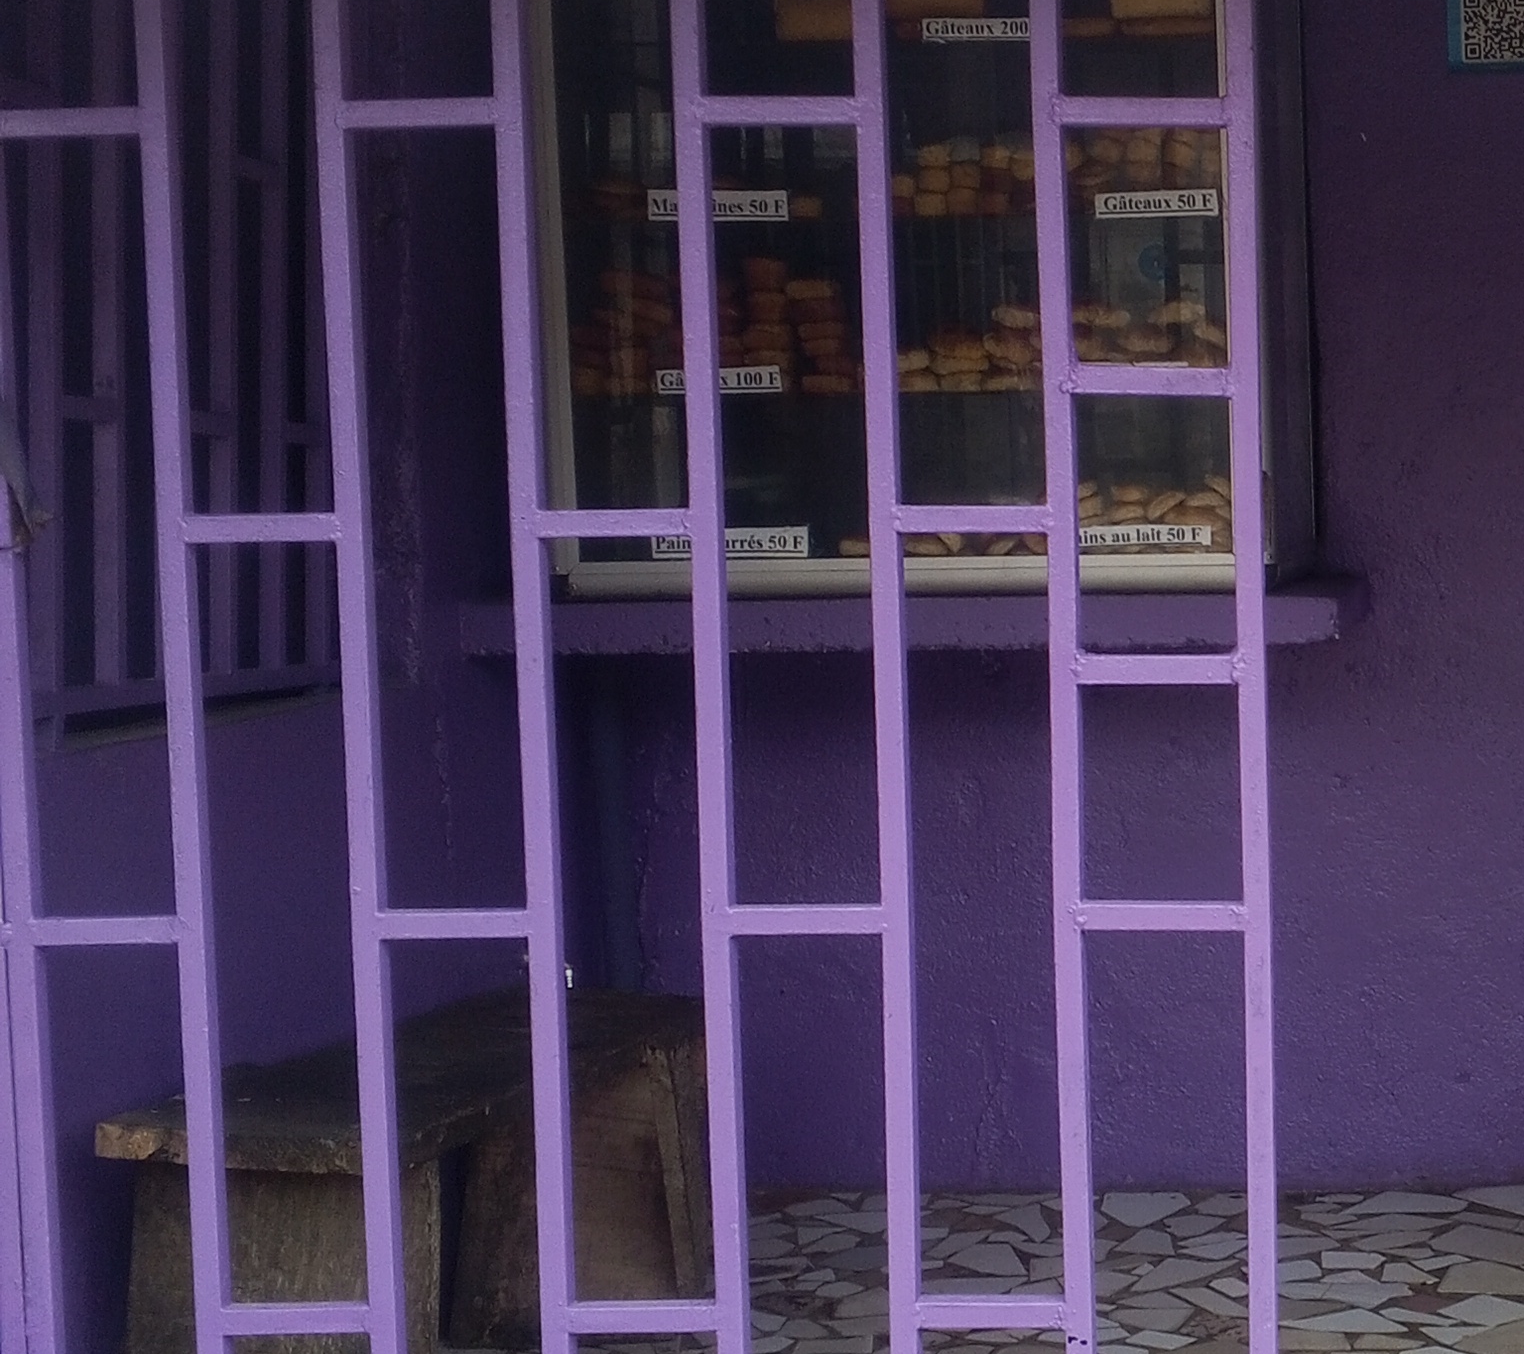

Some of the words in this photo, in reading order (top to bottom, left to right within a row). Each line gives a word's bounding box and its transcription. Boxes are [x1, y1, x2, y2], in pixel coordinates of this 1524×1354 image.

[925, 20, 995, 35] Gâteaux
[1000, 20, 1029, 35] 200
[748, 199, 768, 214] 50
[774, 199, 785, 213] F
[1103, 193, 1172, 210] Gâteaux
[1177, 194, 1196, 209] 50
[1201, 193, 1213, 208] F
[735, 371, 763, 386] 100
[768, 371, 779, 385] F
[768, 535, 787, 549] 50
[793, 535, 804, 549] F
[1111, 531, 1131, 543] au
[1136, 527, 1161, 543] lait
[1166, 527, 1185, 542] 50
[1191, 527, 1202, 541] F
